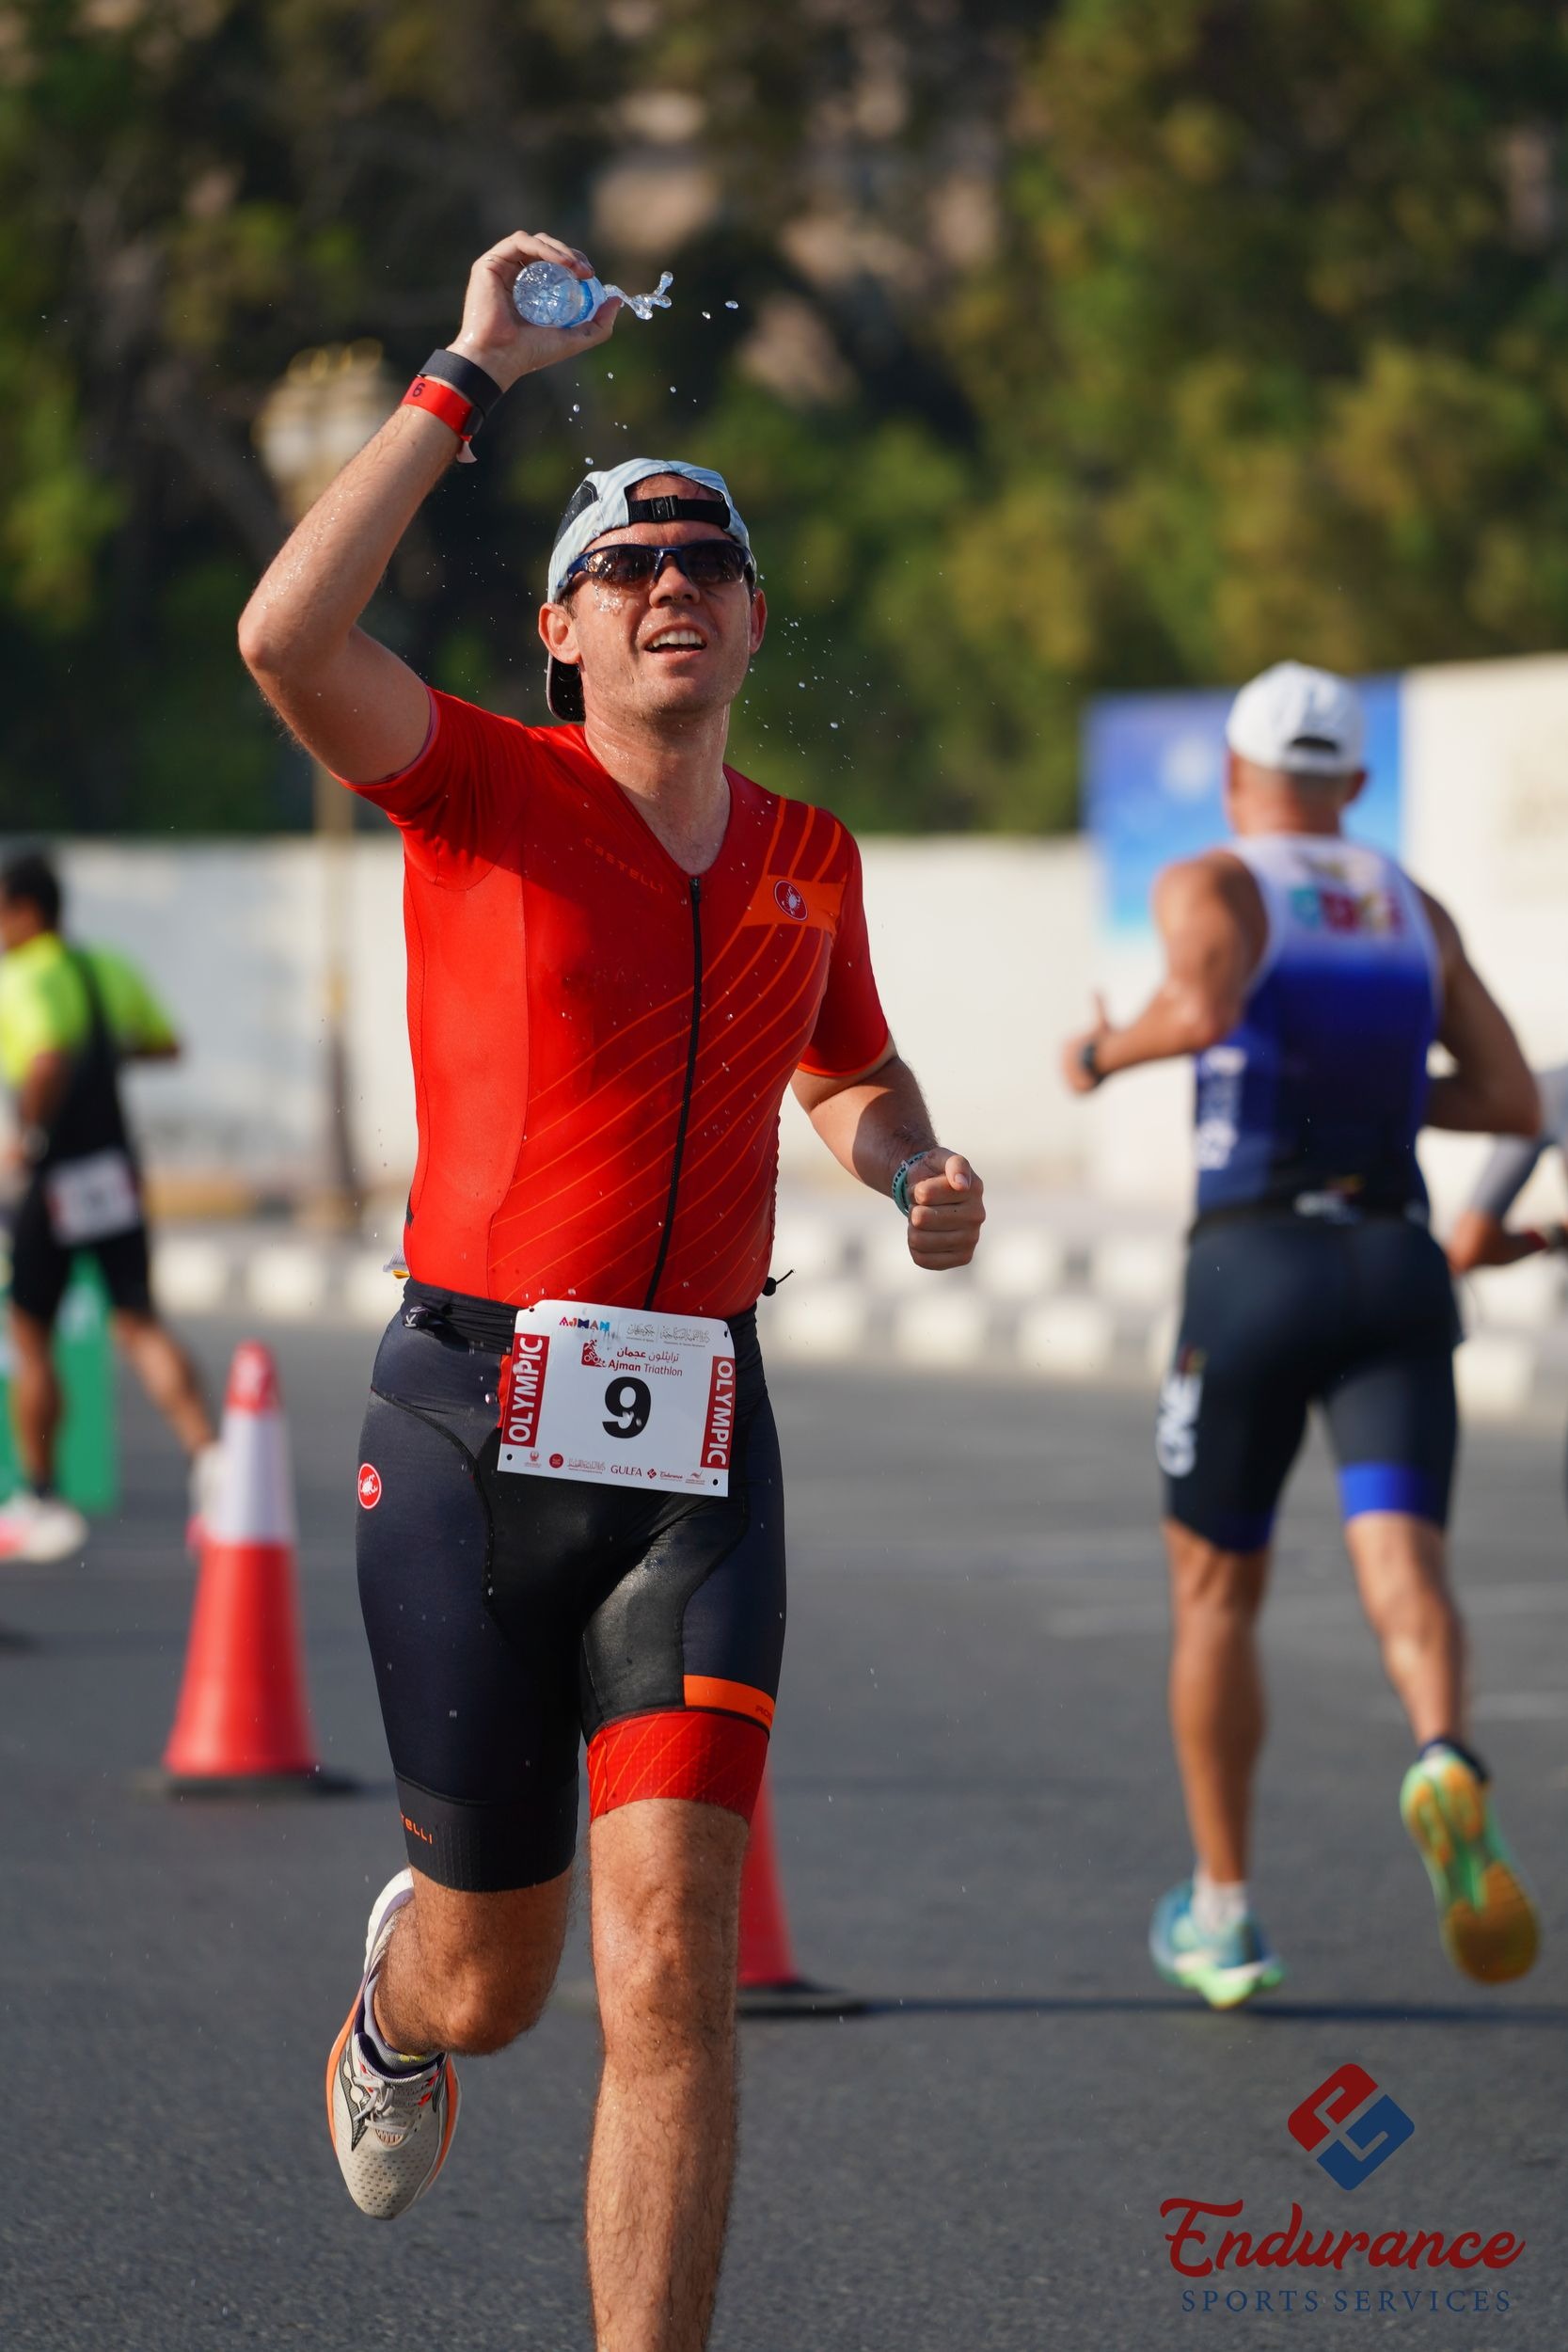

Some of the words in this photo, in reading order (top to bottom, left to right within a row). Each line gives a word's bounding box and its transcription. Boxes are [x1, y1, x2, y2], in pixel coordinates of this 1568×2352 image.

[559, 1316, 610, 1332] AJMAN
[616, 1346, 646, 1359] عجمان
[608, 1359, 641, 1373] Ajman
[643, 1362, 683, 1376] Triathlon
[509, 1337, 543, 1443] OLYMPIC
[602, 1376, 652, 1438] 9
[706, 1360, 734, 1466] OLYMPIC
[610, 1465, 642, 1477] GULFA
